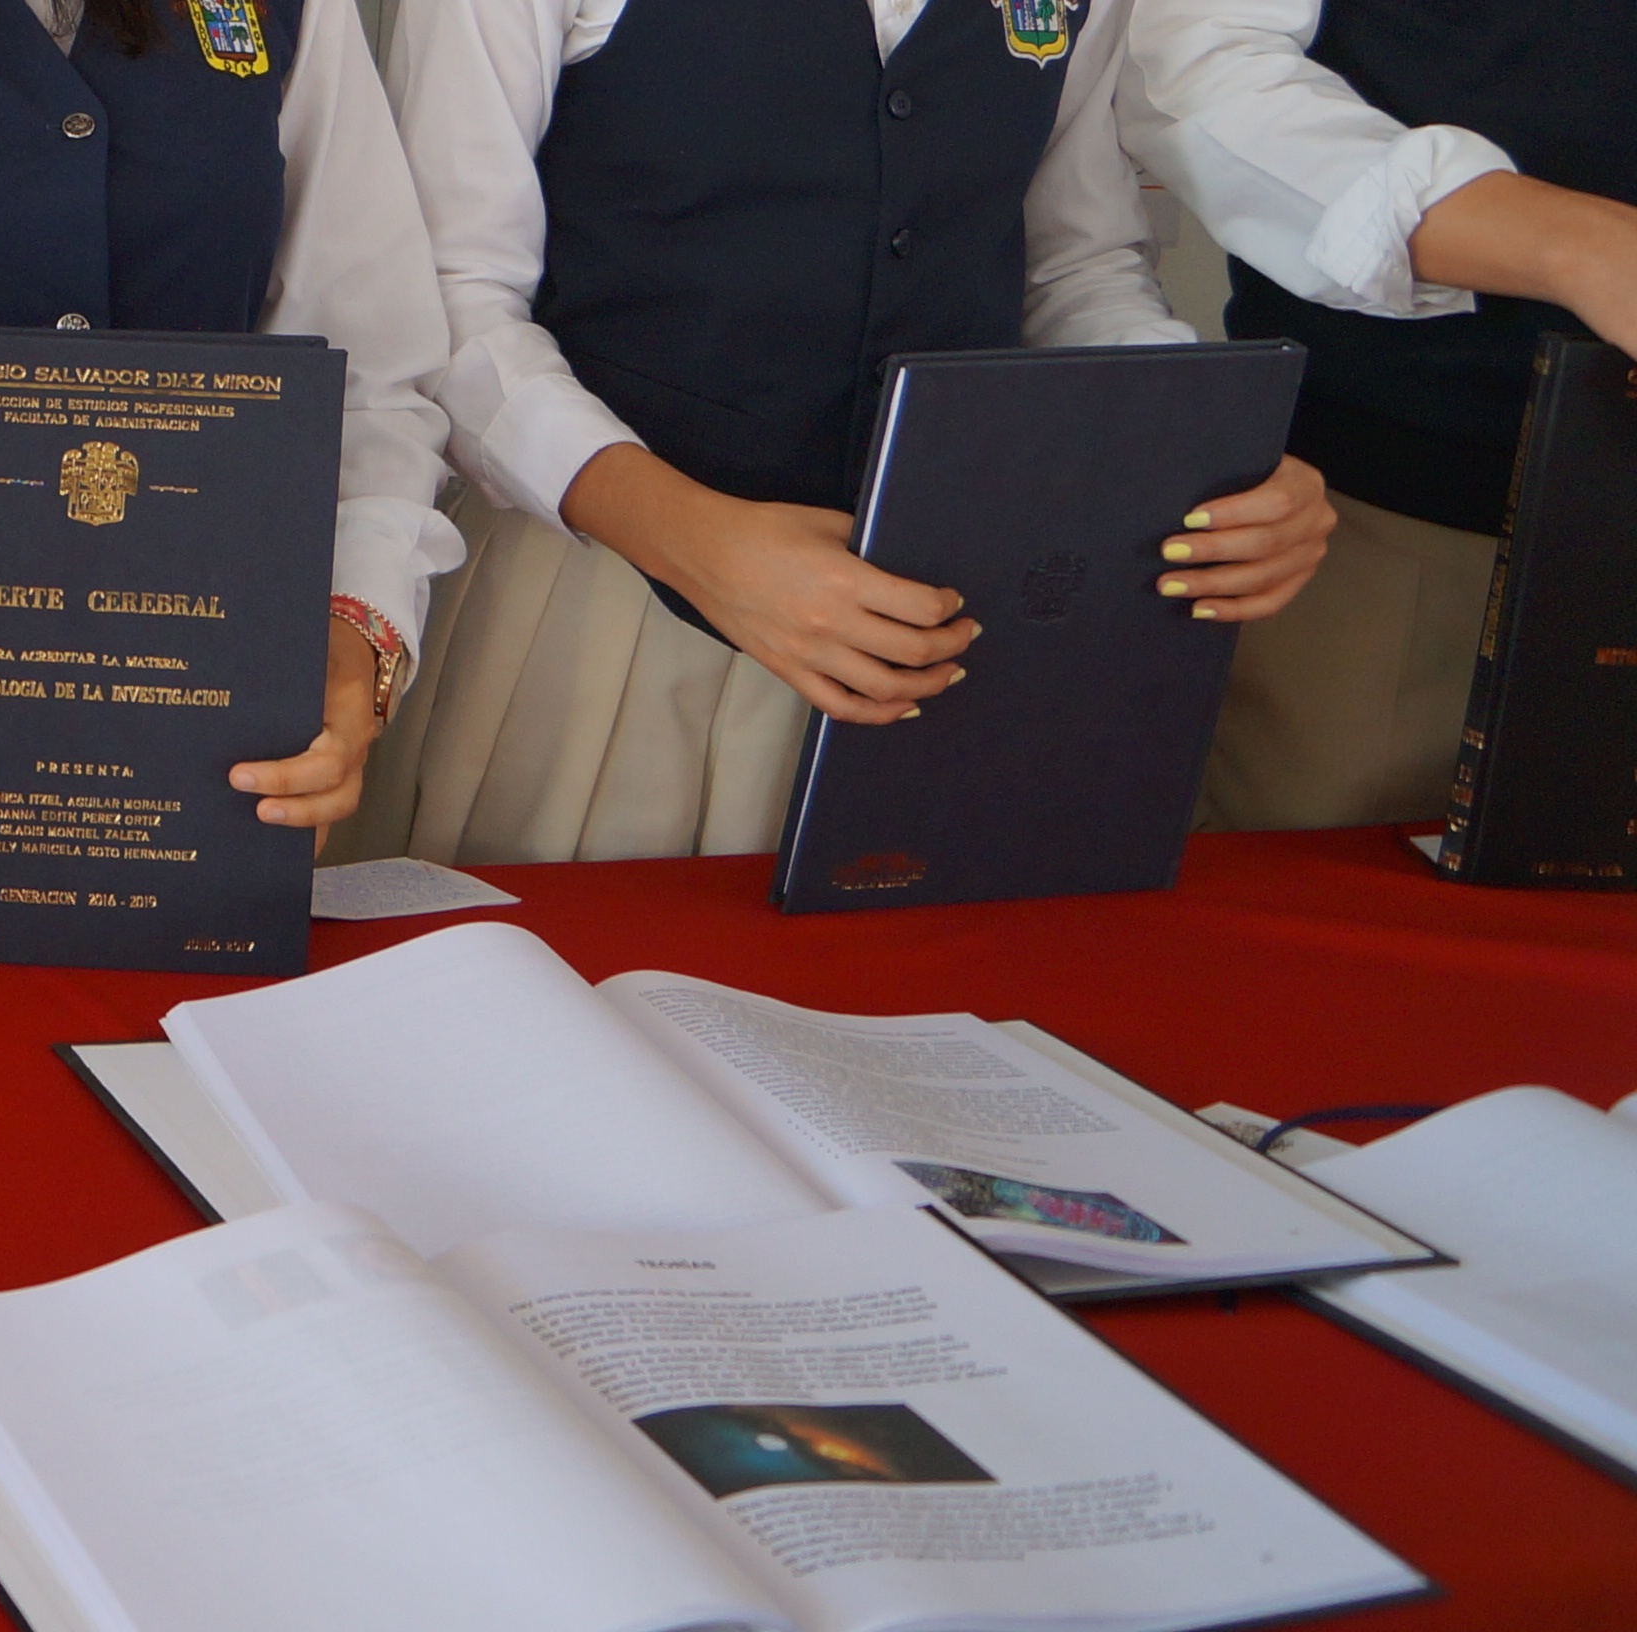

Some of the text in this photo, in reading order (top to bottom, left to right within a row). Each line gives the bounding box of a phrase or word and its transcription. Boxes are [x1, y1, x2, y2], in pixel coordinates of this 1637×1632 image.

[35, 367, 149, 388] SALVADOR
[157, 373, 205, 389] DIAZ
[213, 375, 281, 392] MIRON
[46, 398, 62, 410] DE
[68, 399, 128, 413] ESTUDIOS
[134, 402, 234, 417] PROFESIONALES
[87, 590, 225, 619] CEREBRAL
